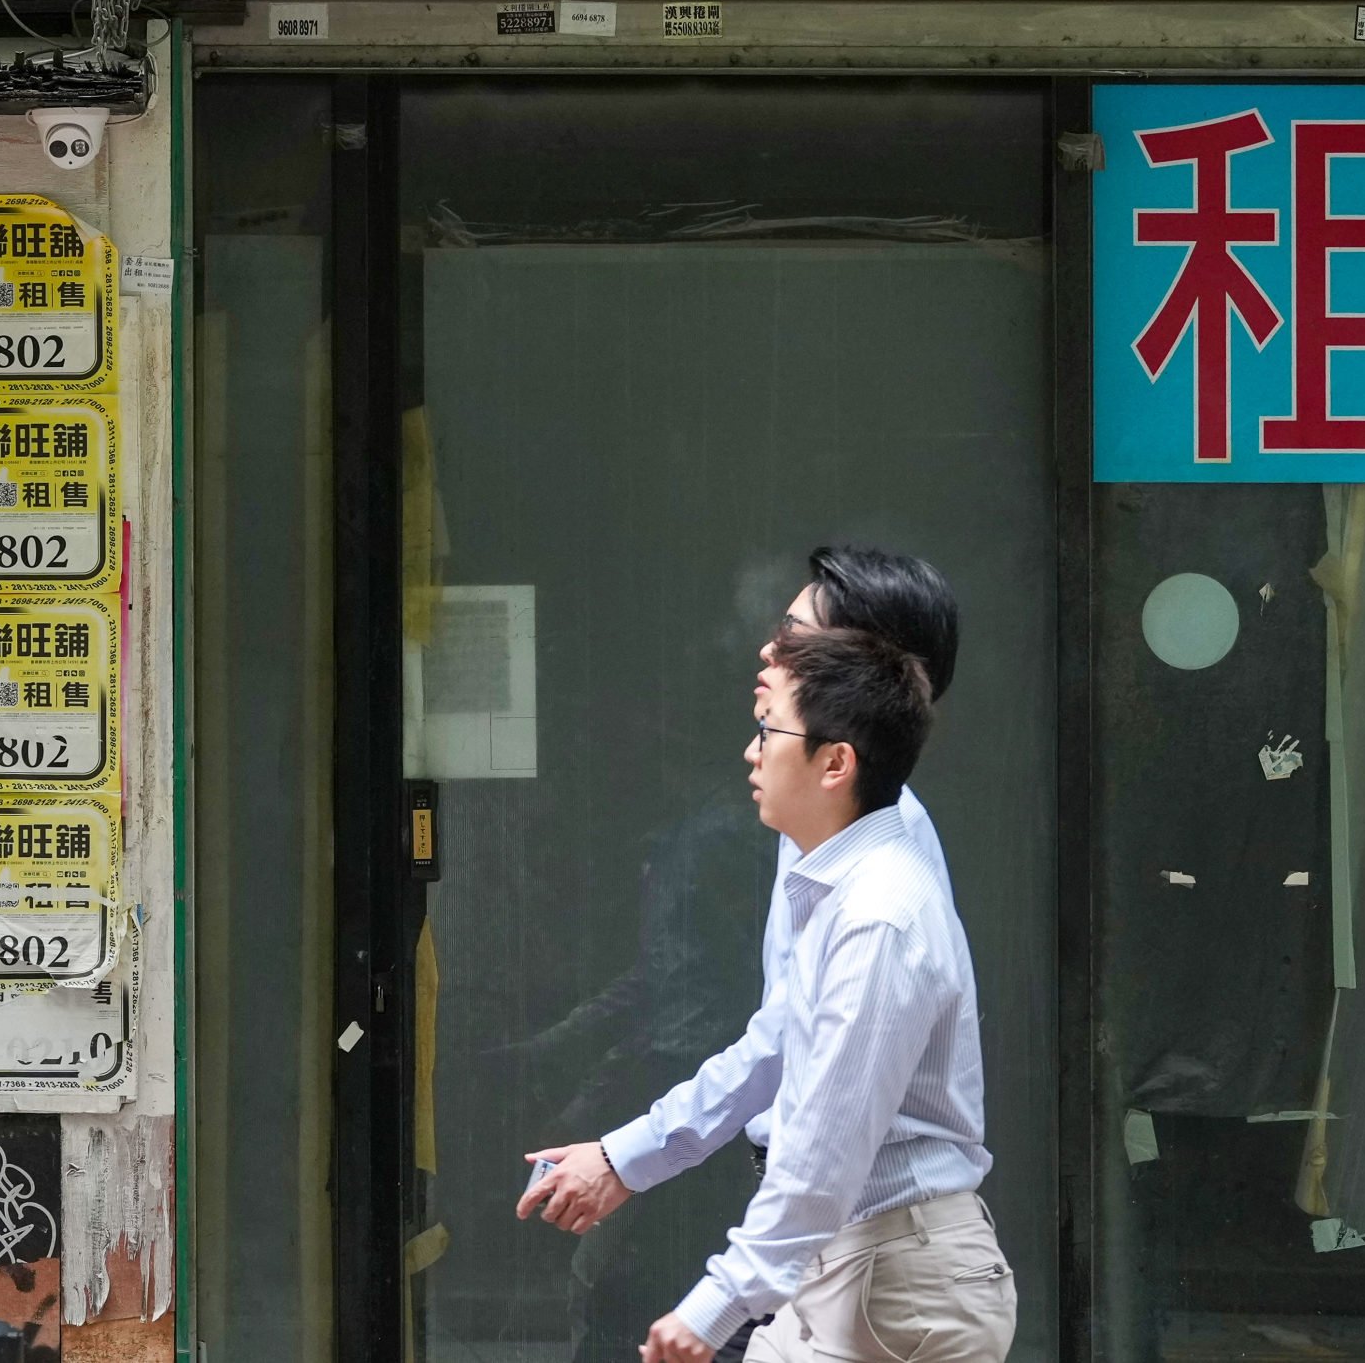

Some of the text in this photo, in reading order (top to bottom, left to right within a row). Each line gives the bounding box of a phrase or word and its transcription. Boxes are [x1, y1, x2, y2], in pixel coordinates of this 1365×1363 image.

[501, 17, 553, 28] 52288971
[589, 14, 605, 23] 6878
[278, 20, 317, 35] 9608 8971
